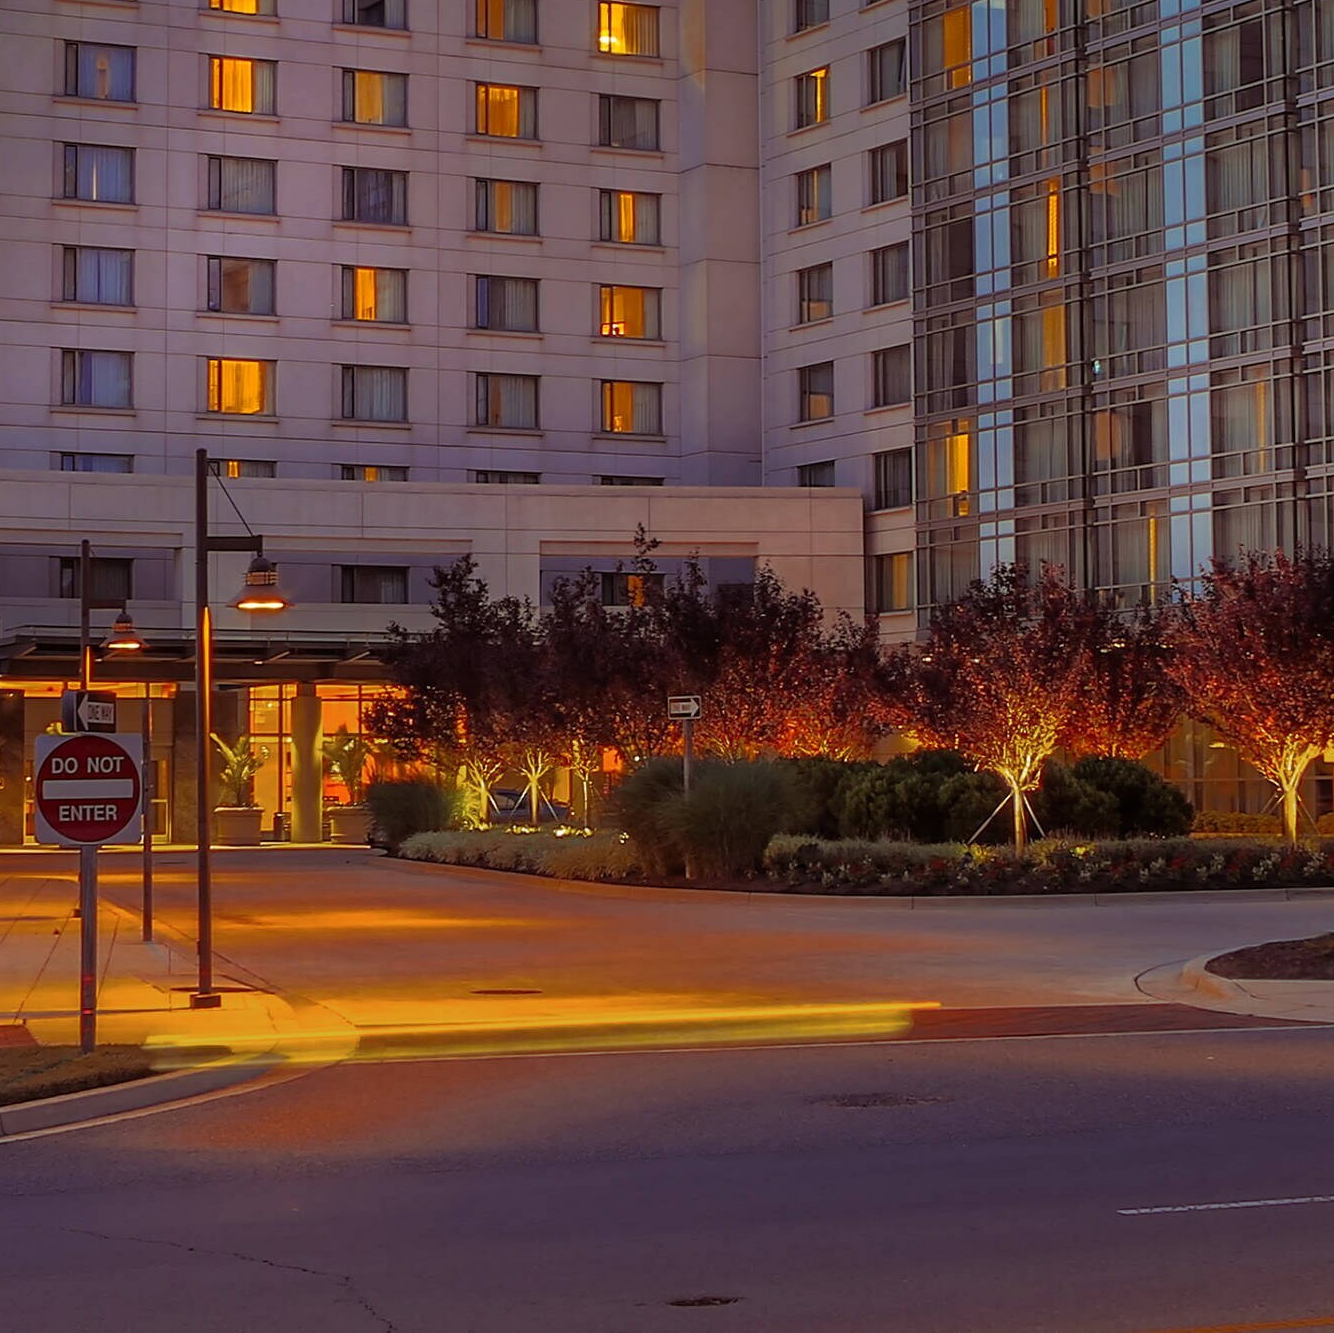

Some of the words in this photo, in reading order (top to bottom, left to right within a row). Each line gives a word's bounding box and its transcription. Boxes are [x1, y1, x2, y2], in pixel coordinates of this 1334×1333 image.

[51, 757, 79, 774] DO
[86, 756, 125, 773] NOT
[58, 804, 118, 822] ENTER
